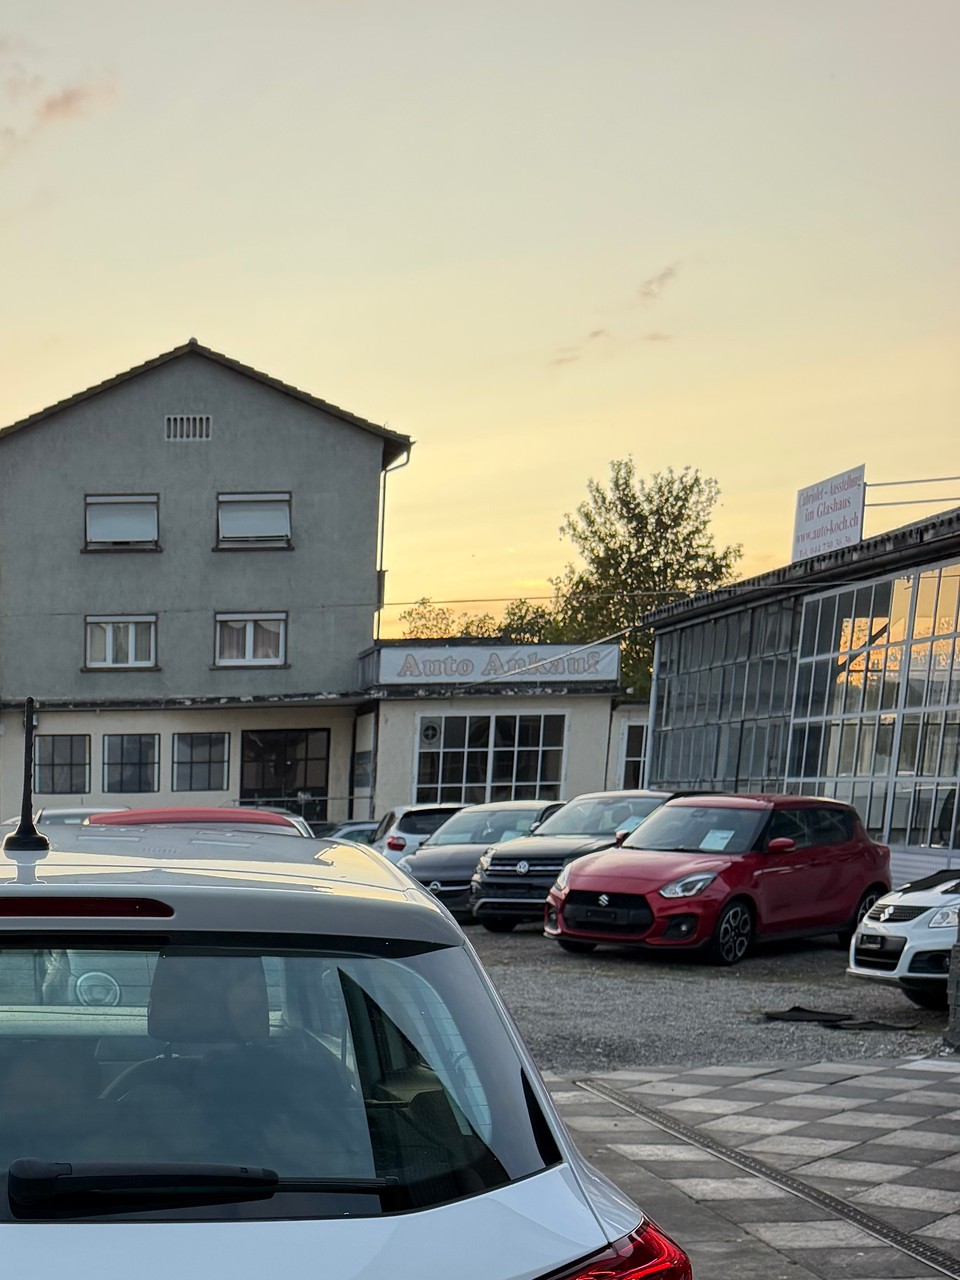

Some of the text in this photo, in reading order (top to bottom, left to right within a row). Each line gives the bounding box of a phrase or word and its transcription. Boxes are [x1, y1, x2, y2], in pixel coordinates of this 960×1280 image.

[817, 497, 851, 518] Glashaus
[397, 651, 601, 677] Auto Ankauf
